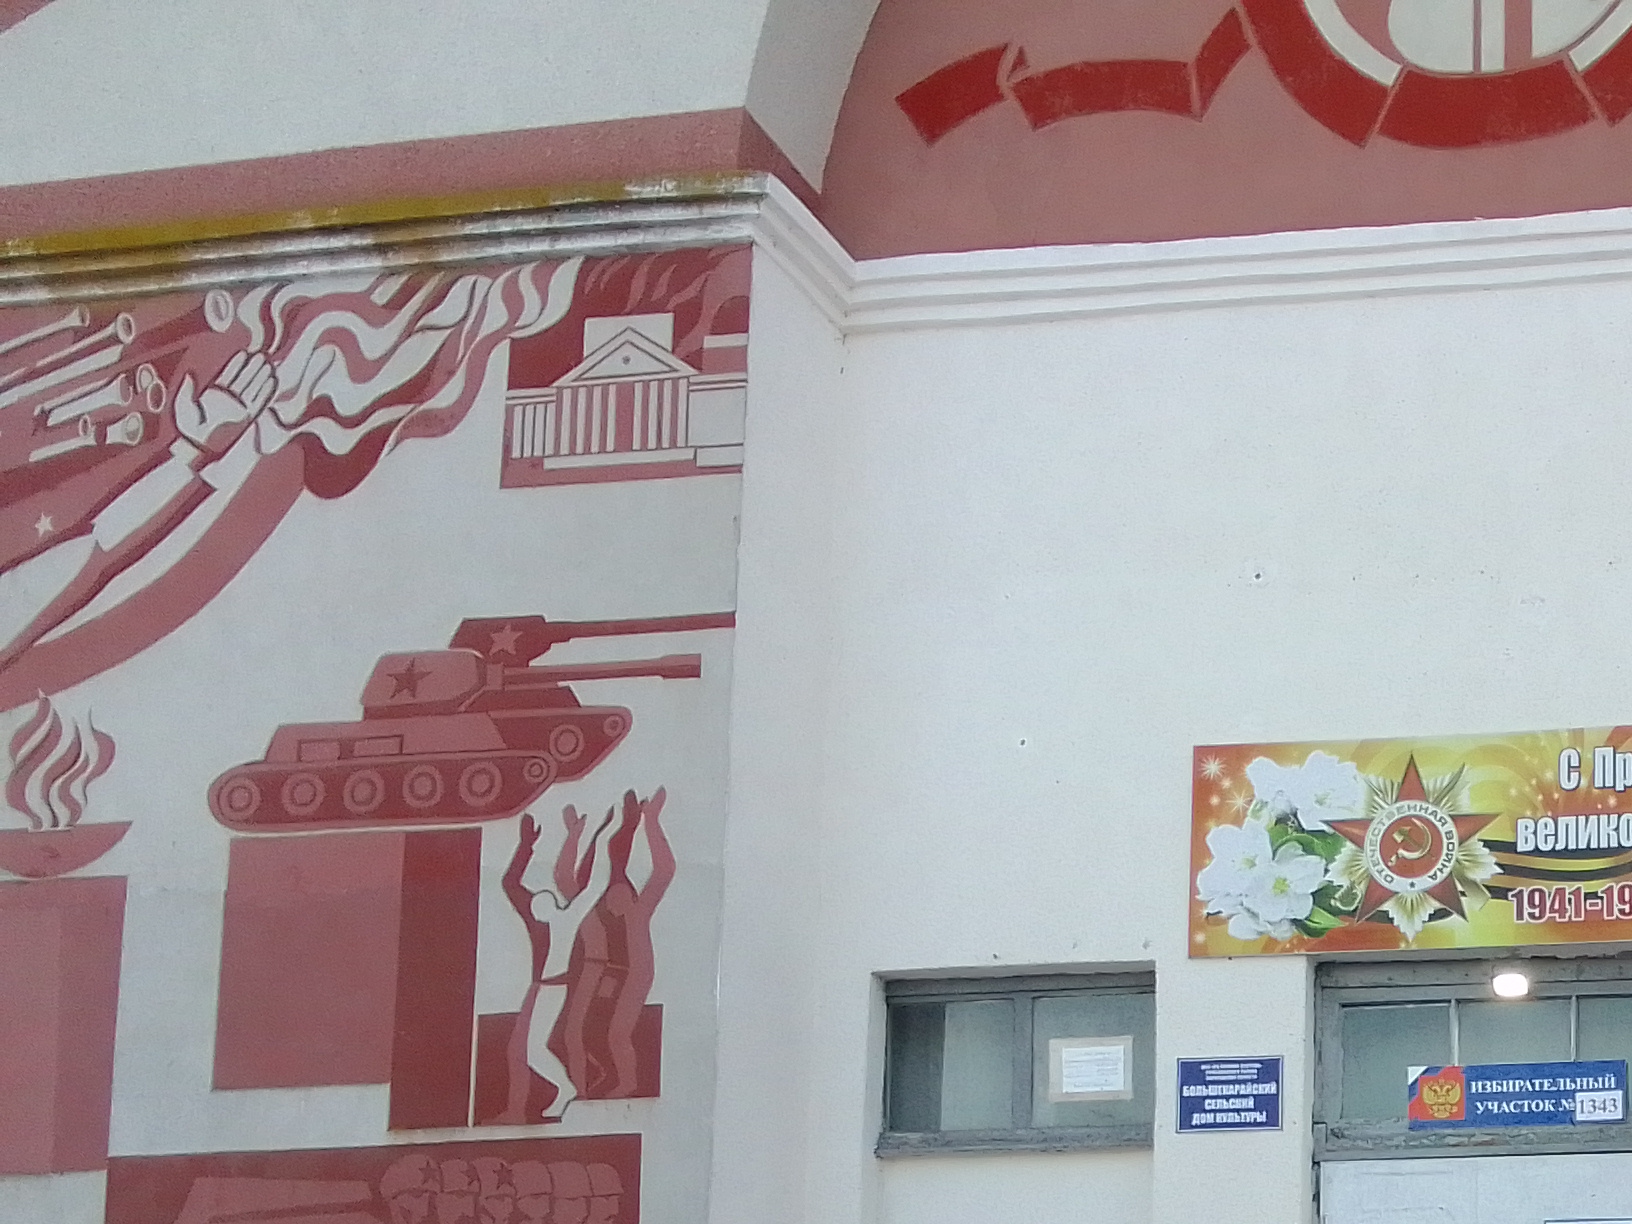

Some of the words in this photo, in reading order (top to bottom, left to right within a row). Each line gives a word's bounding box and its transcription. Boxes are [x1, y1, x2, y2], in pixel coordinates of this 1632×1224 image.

[1558, 748, 1581, 791] С
[1369, 804, 1449, 884] ОТЕЧЕСТЕННАЯ
[1470, 1073, 1617, 1094] ИЗБИРАТЕЛЬНЫЙ
[1204, 1095, 1255, 1111] СЕЛЬСКИЙ
[1475, 1099, 1556, 1115] УЧАСТОК
[1191, 1112, 1215, 1126] ДОМ
[1215, 1110, 1267, 1124] КУЛЬТУРЫ
